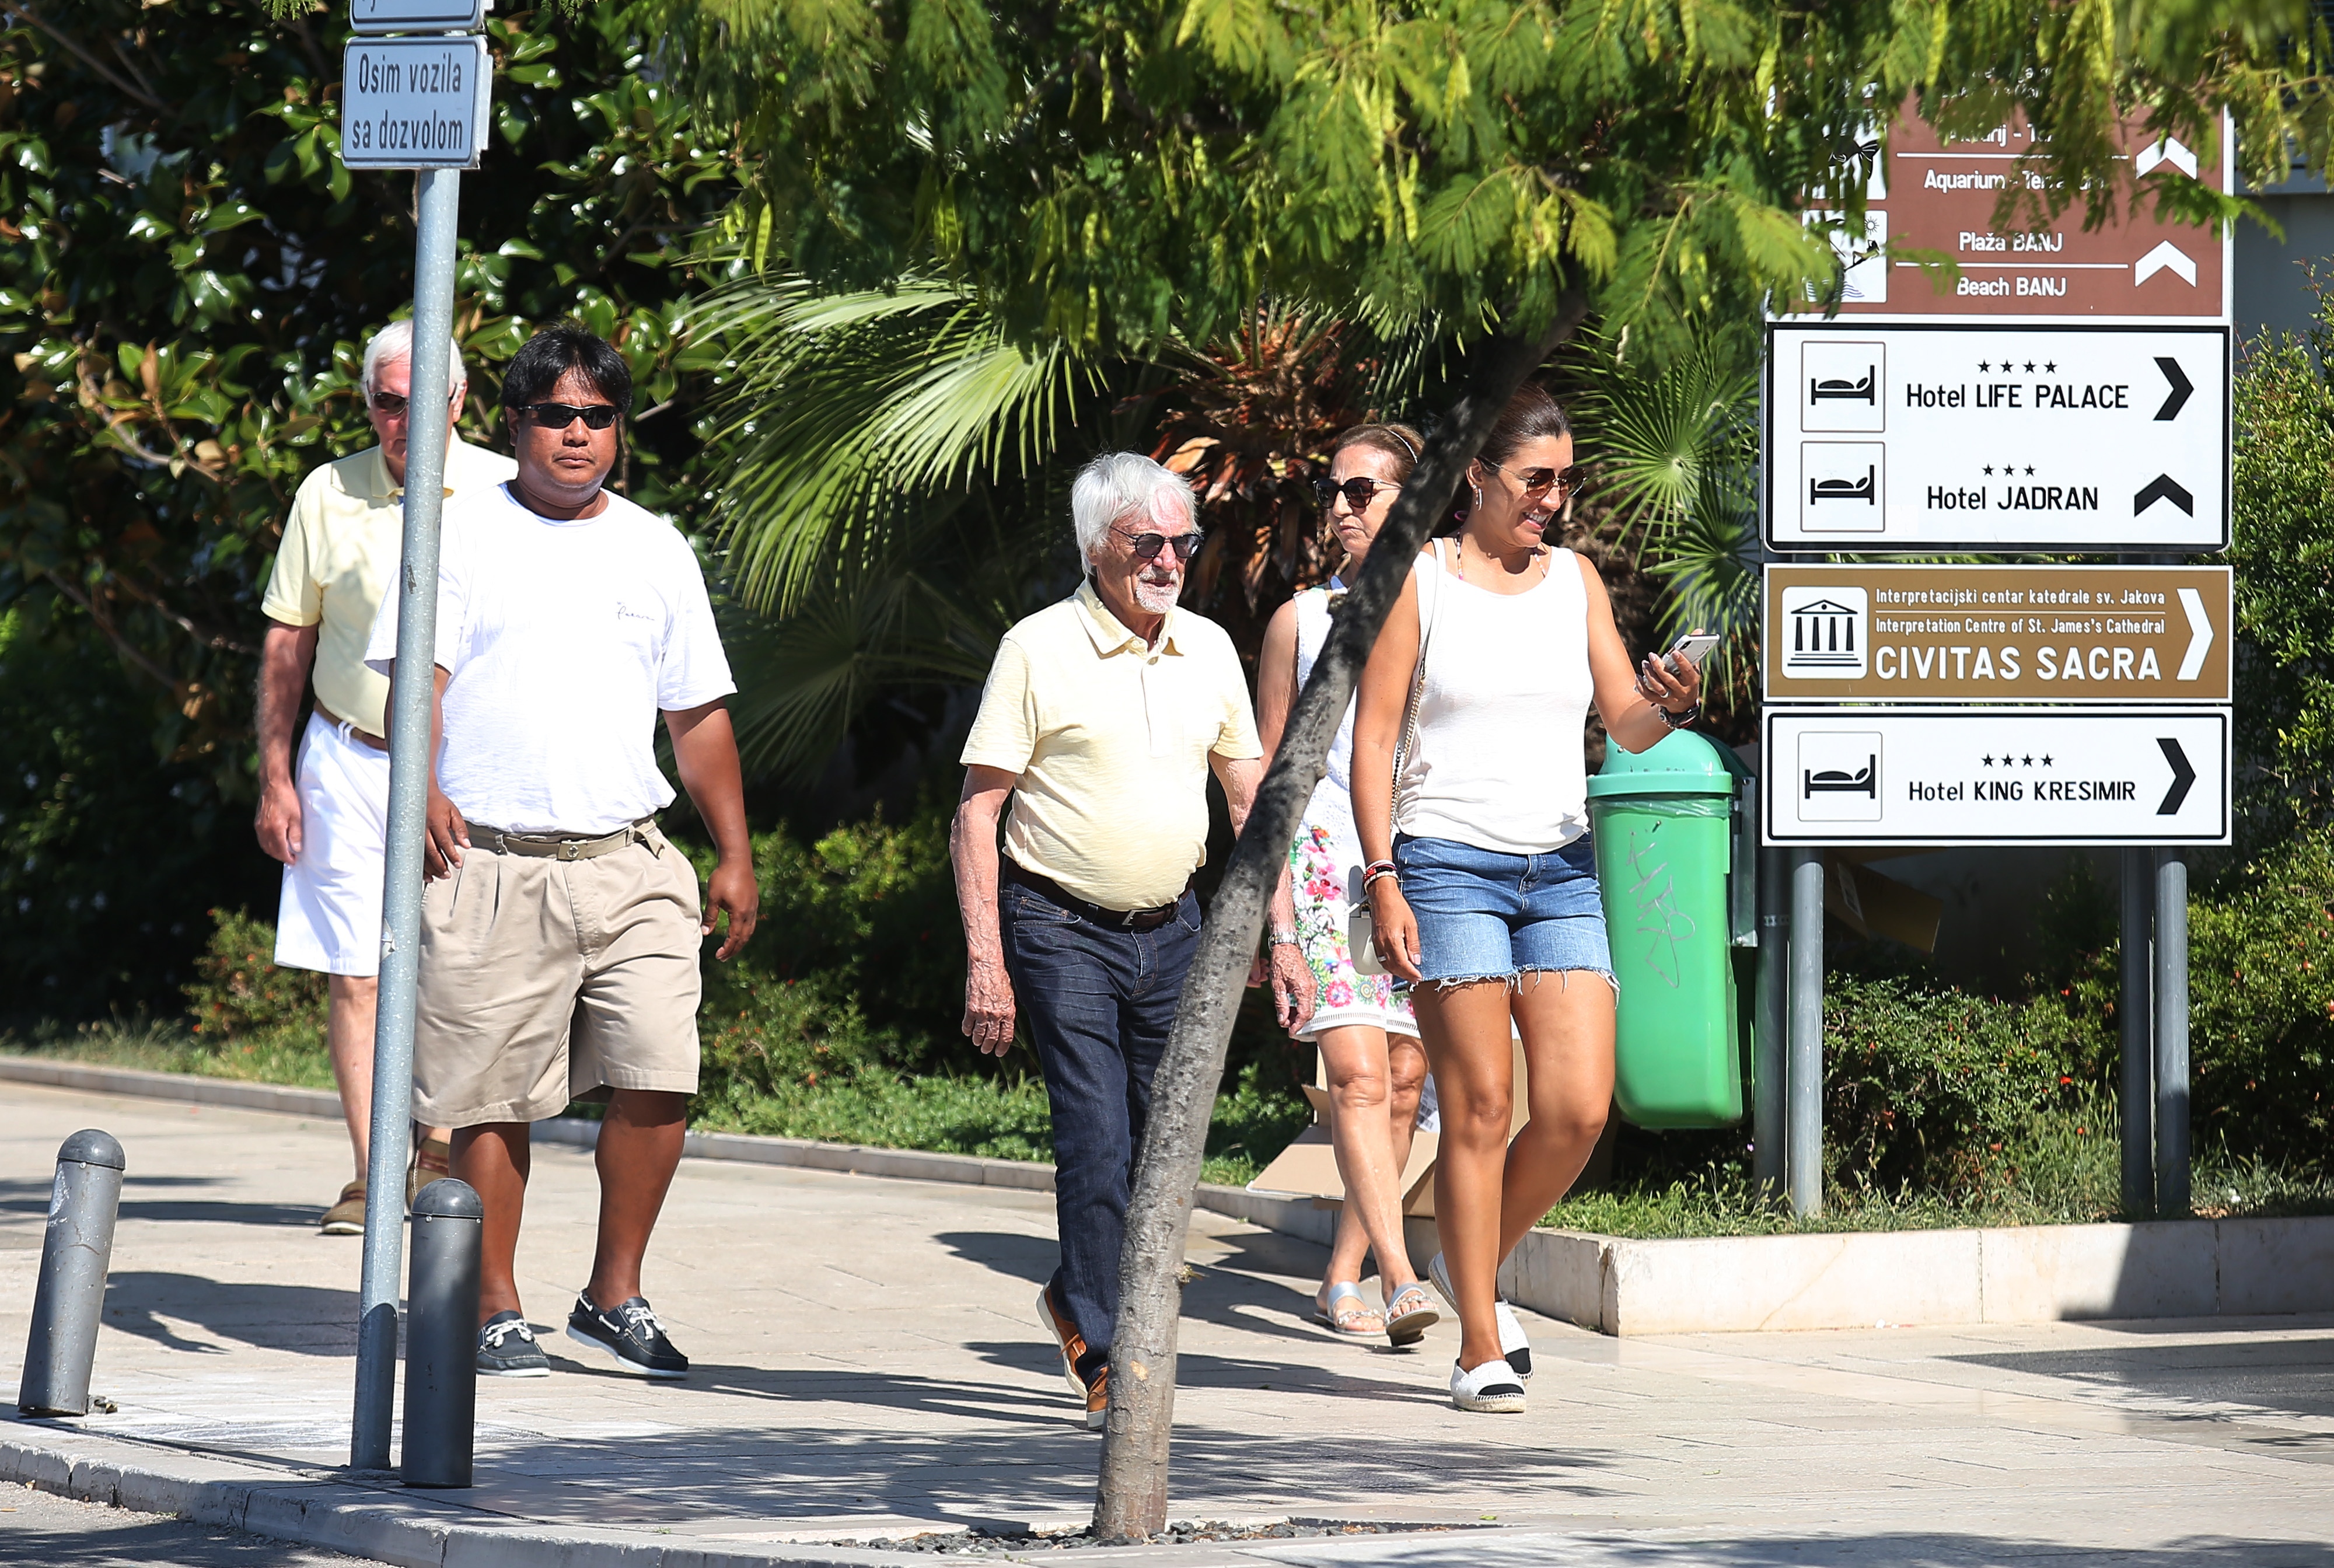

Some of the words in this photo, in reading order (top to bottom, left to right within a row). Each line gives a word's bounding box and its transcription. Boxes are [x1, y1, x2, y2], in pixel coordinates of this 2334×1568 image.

[359, 53, 400, 93] Osim
[410, 53, 461, 93] vozila
[352, 120, 371, 149] sa
[379, 109, 463, 149] dozvolom
[1924, 169, 2005, 193] Aquarium
[1959, 232, 2006, 252] Plaža
[2013, 232, 2063, 252] BANJ
[1956, 277, 2010, 296] Beach
[2016, 277, 2066, 296] BANJ
[1907, 383, 1965, 408] Hotel
[1976, 384, 2022, 408] LIFE
[2036, 385, 2129, 408] PALACE
[1927, 486, 1986, 510] Hotel
[1997, 486, 2098, 510] JADRAN
[1876, 588, 1977, 607] Interpretacijski
[1982, 589, 2024, 603] centar
[2029, 589, 2090, 604] katedrale
[2096, 592, 2115, 604] sv.
[2120, 589, 2165, 605] Jakova
[1876, 617, 1961, 636] Interpretation
[1965, 618, 2005, 633] Centre
[2011, 618, 2024, 633] of
[2028, 618, 2046, 633] St.
[2050, 618, 2102, 633] James's
[2106, 618, 2164, 634] Cathedral
[1876, 646, 2021, 680] CIVITAS
[2036, 647, 2161, 680] SACRA
[1909, 781, 1963, 801] Hotel
[1974, 781, 2023, 801] KING
[2034, 781, 2136, 801] KRESIMIR
